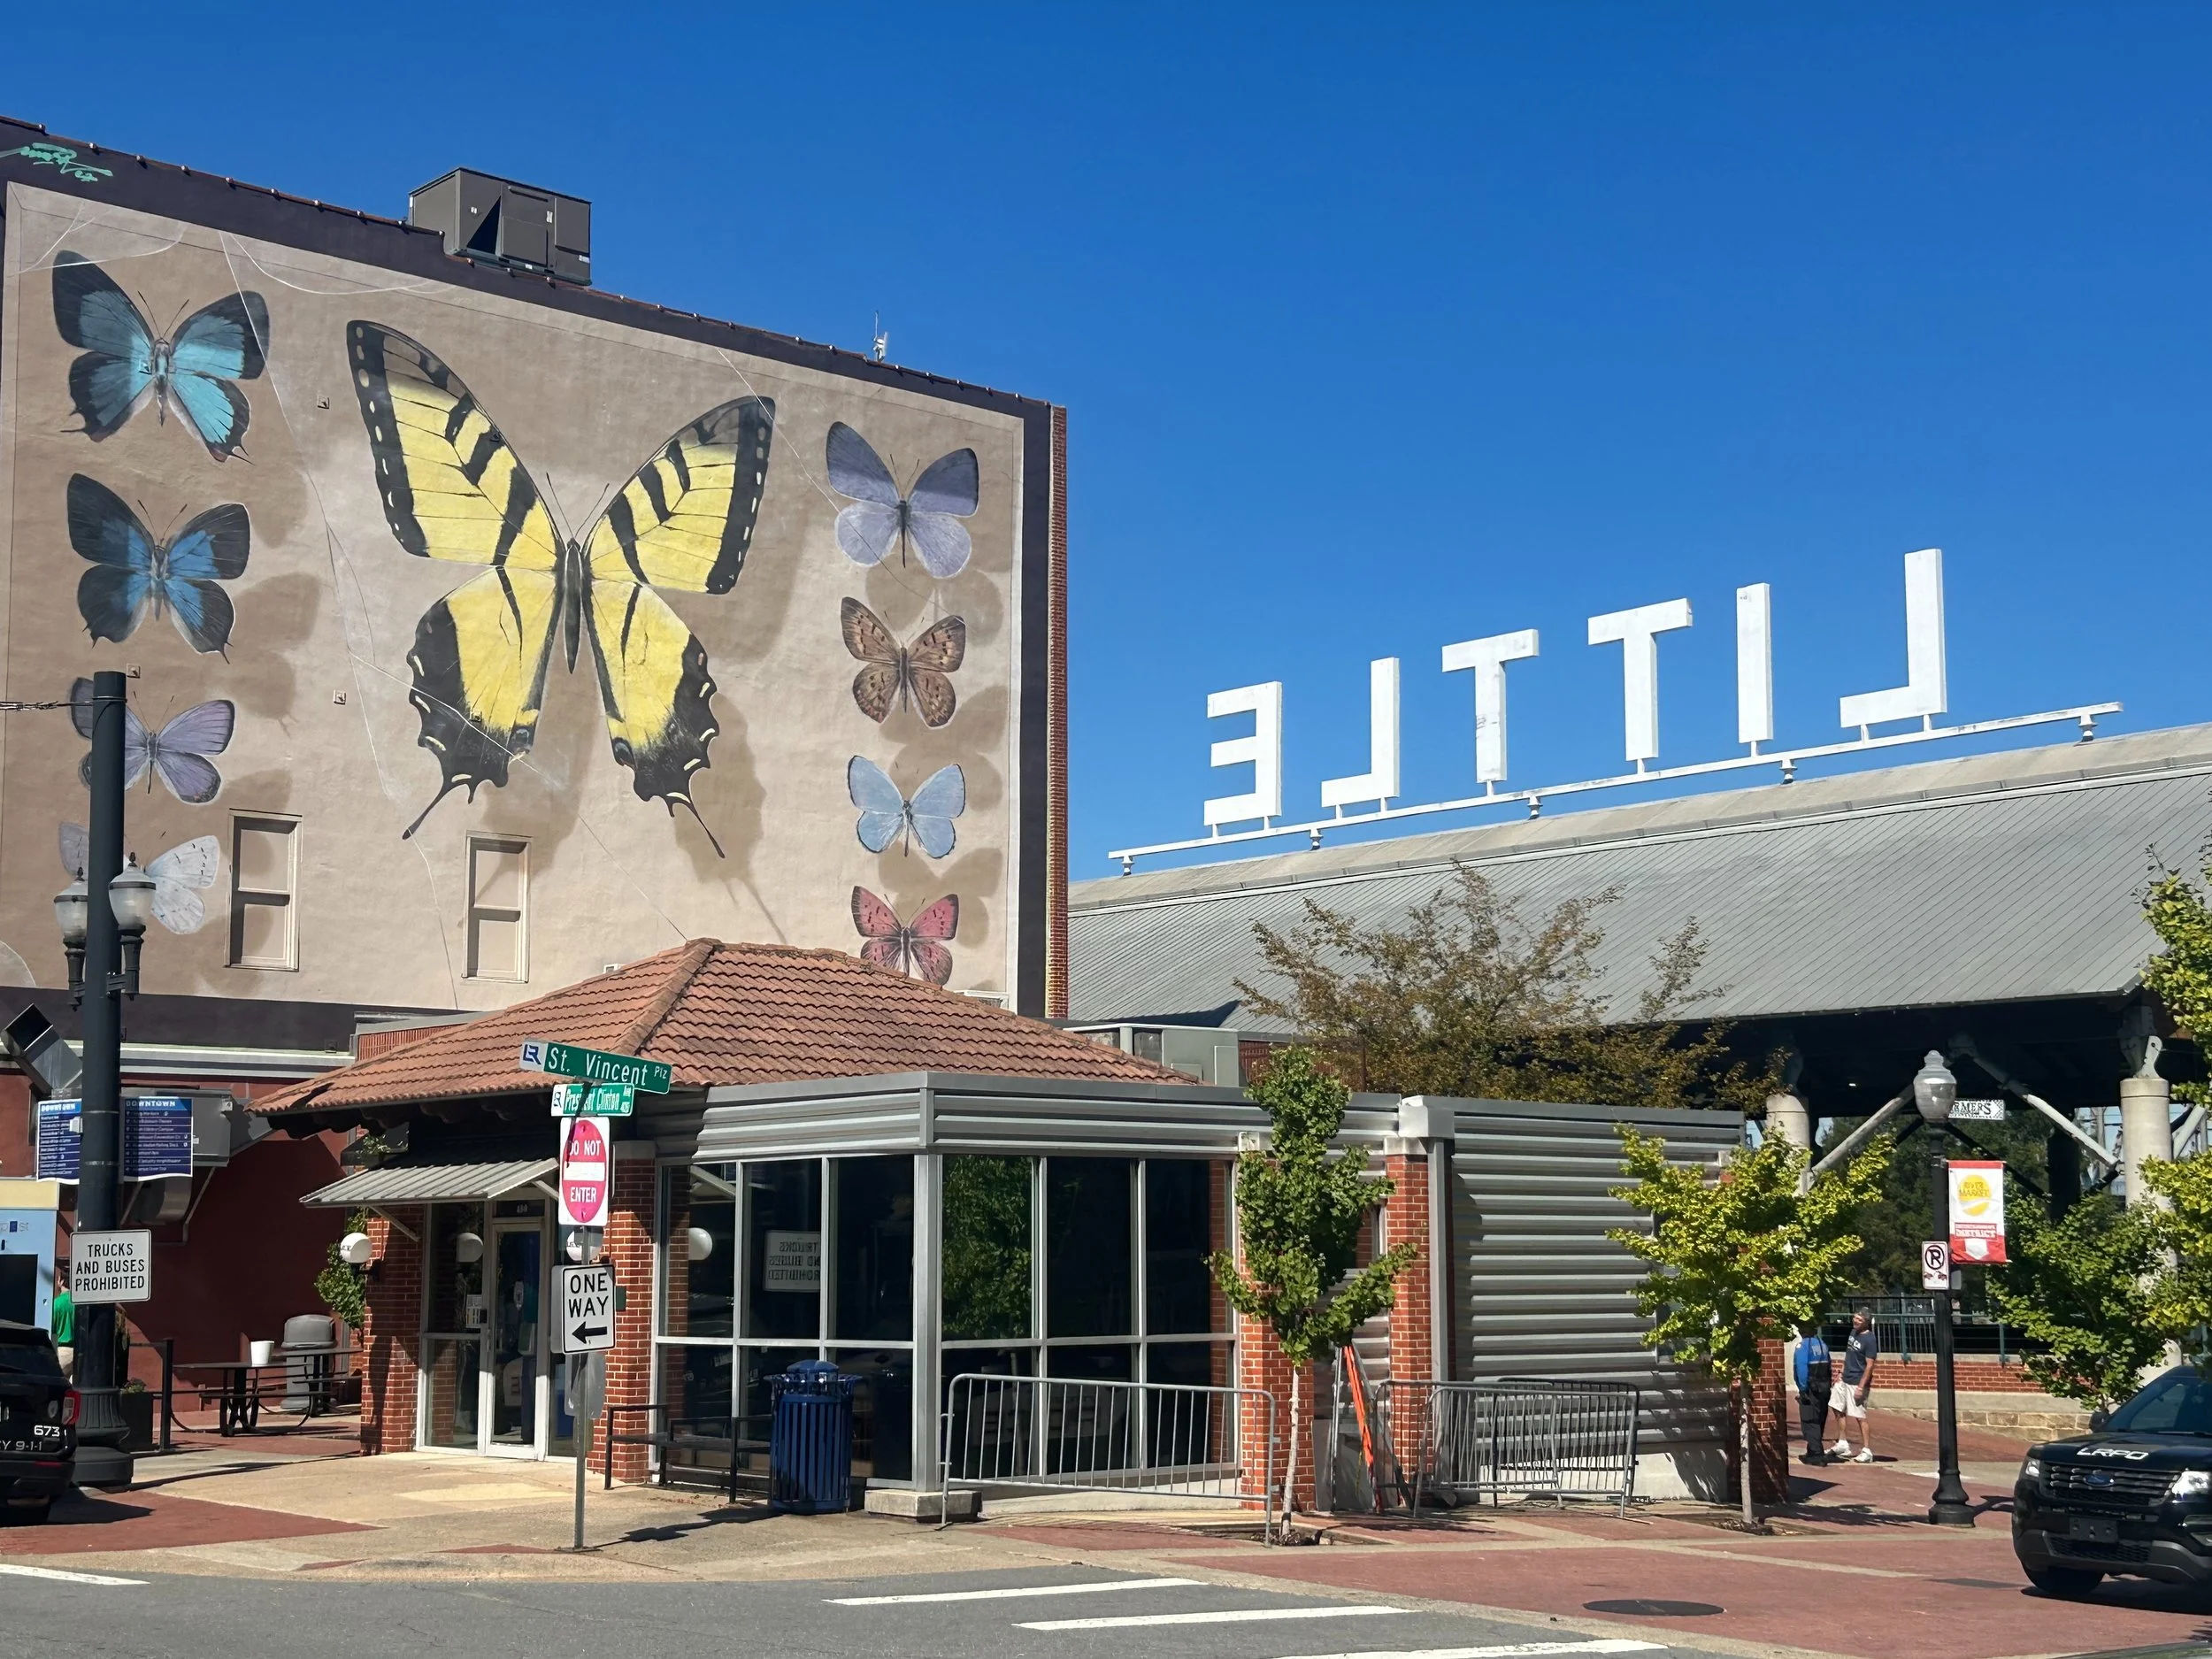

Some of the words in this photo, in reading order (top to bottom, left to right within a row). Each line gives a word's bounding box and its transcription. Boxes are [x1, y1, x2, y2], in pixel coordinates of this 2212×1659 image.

[549, 1048, 571, 1073] St.
[586, 1053, 648, 1087] Vincent
[654, 1065, 667, 1079] Plz
[584, 1140, 601, 1156] NOT
[570, 1187, 597, 1202] ENTER
[88, 1243, 134, 1257] TRUCKS
[76, 1261, 99, 1275] AND
[105, 1259, 145, 1273] BUSES
[75, 1275, 144, 1292] PROHIBITED
[570, 1272, 608, 1294] ONE
[568, 1295, 609, 1318] WAY
[34, 1425, 60, 1437] 673
[16, 1440, 42, 1451] 9-1-1
